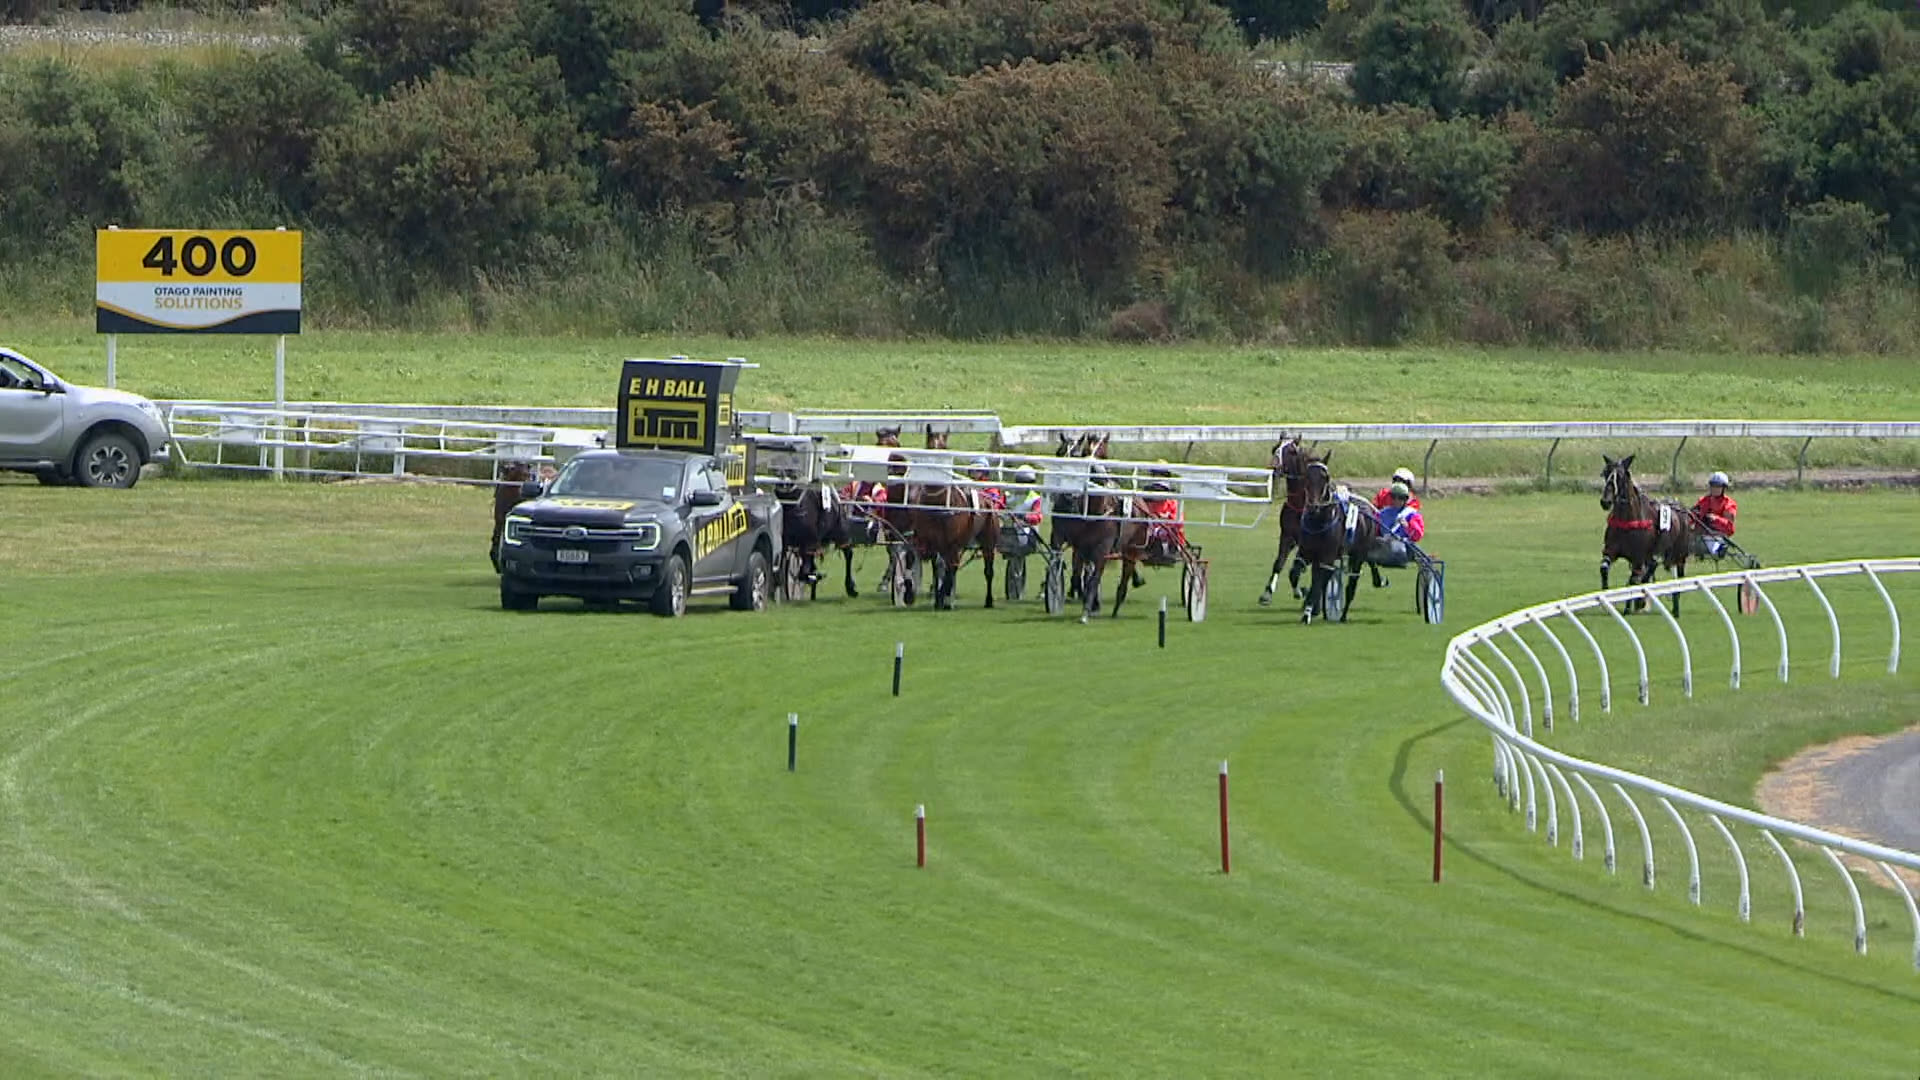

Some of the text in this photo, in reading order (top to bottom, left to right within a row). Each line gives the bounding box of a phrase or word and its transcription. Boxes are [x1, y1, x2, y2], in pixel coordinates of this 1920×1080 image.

[142, 236, 257, 277] 400
[154, 287, 243, 297] OTAGO PAINTING
[154, 297, 243, 310] SOLUTIONS
[629, 377, 707, 398] E H BALL
